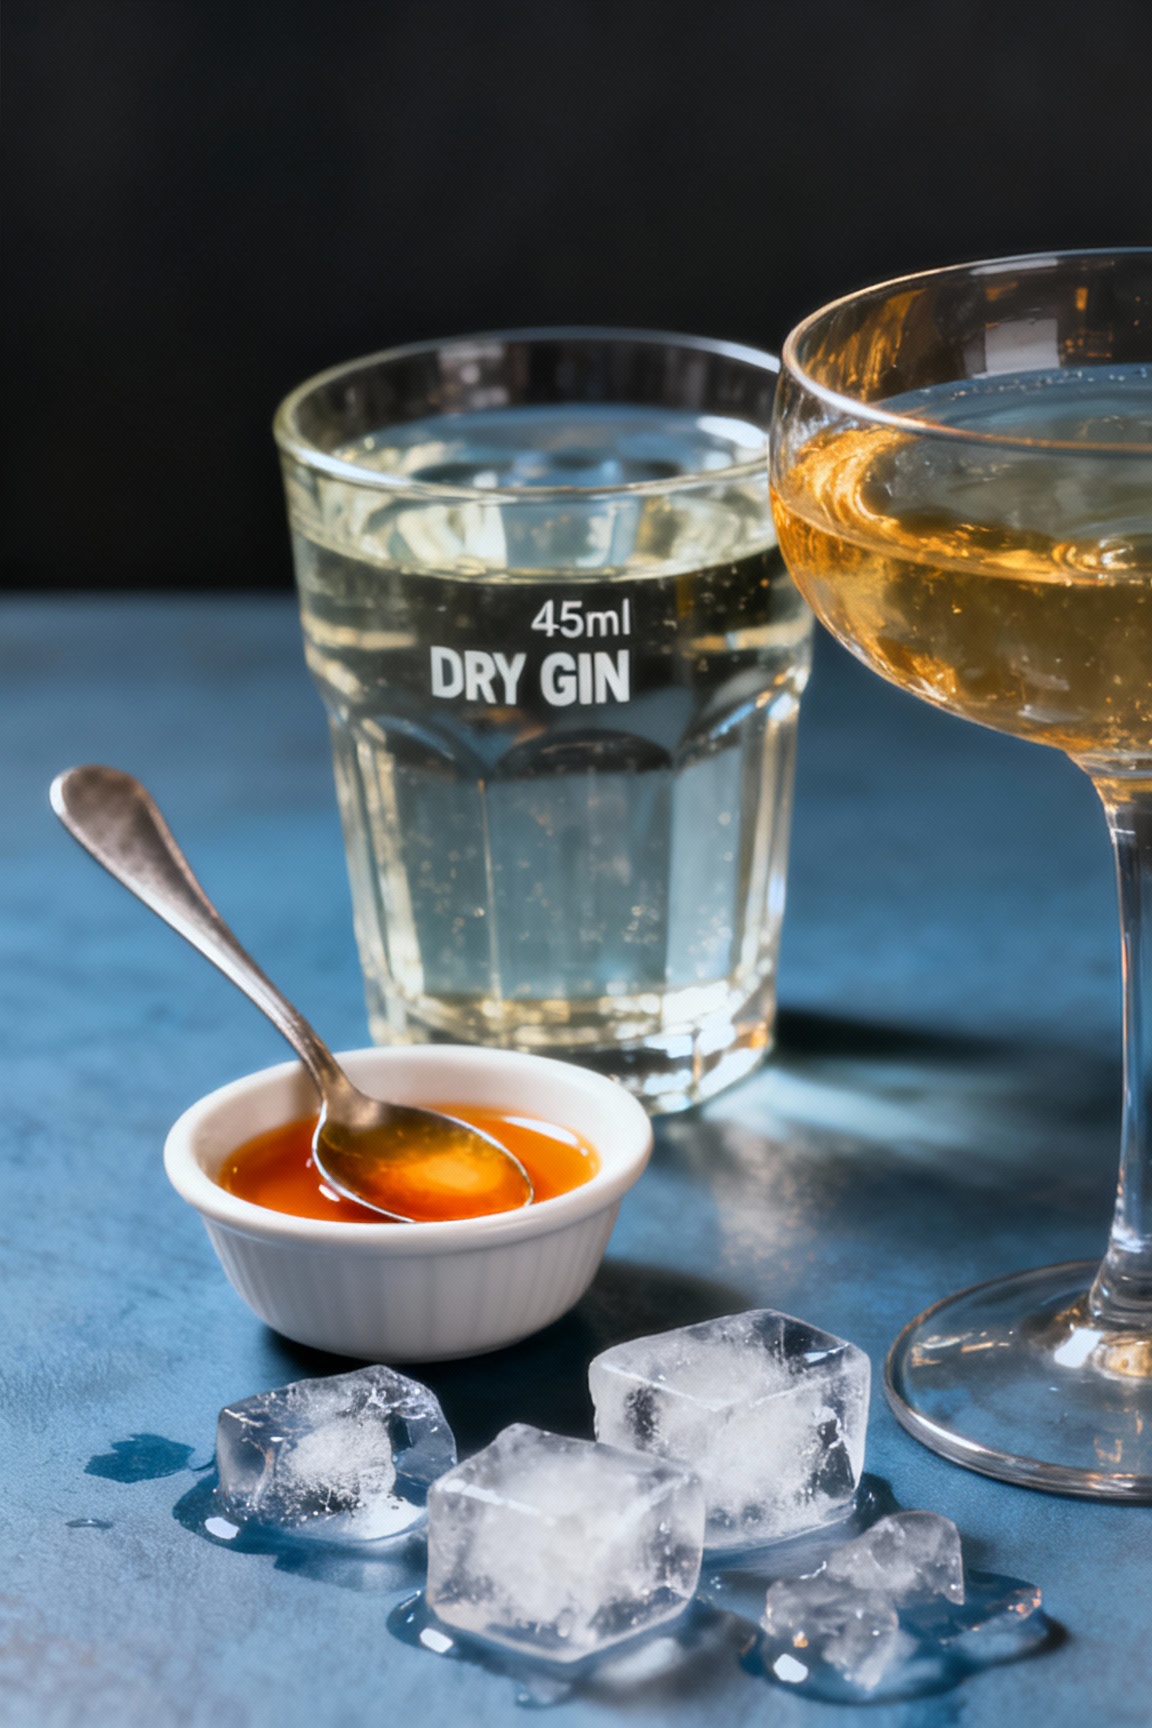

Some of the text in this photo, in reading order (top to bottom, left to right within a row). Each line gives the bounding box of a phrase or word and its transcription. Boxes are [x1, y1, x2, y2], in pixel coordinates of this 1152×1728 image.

[531, 598, 631, 638] 45ml
[430, 645, 630, 707] DRY GIN
